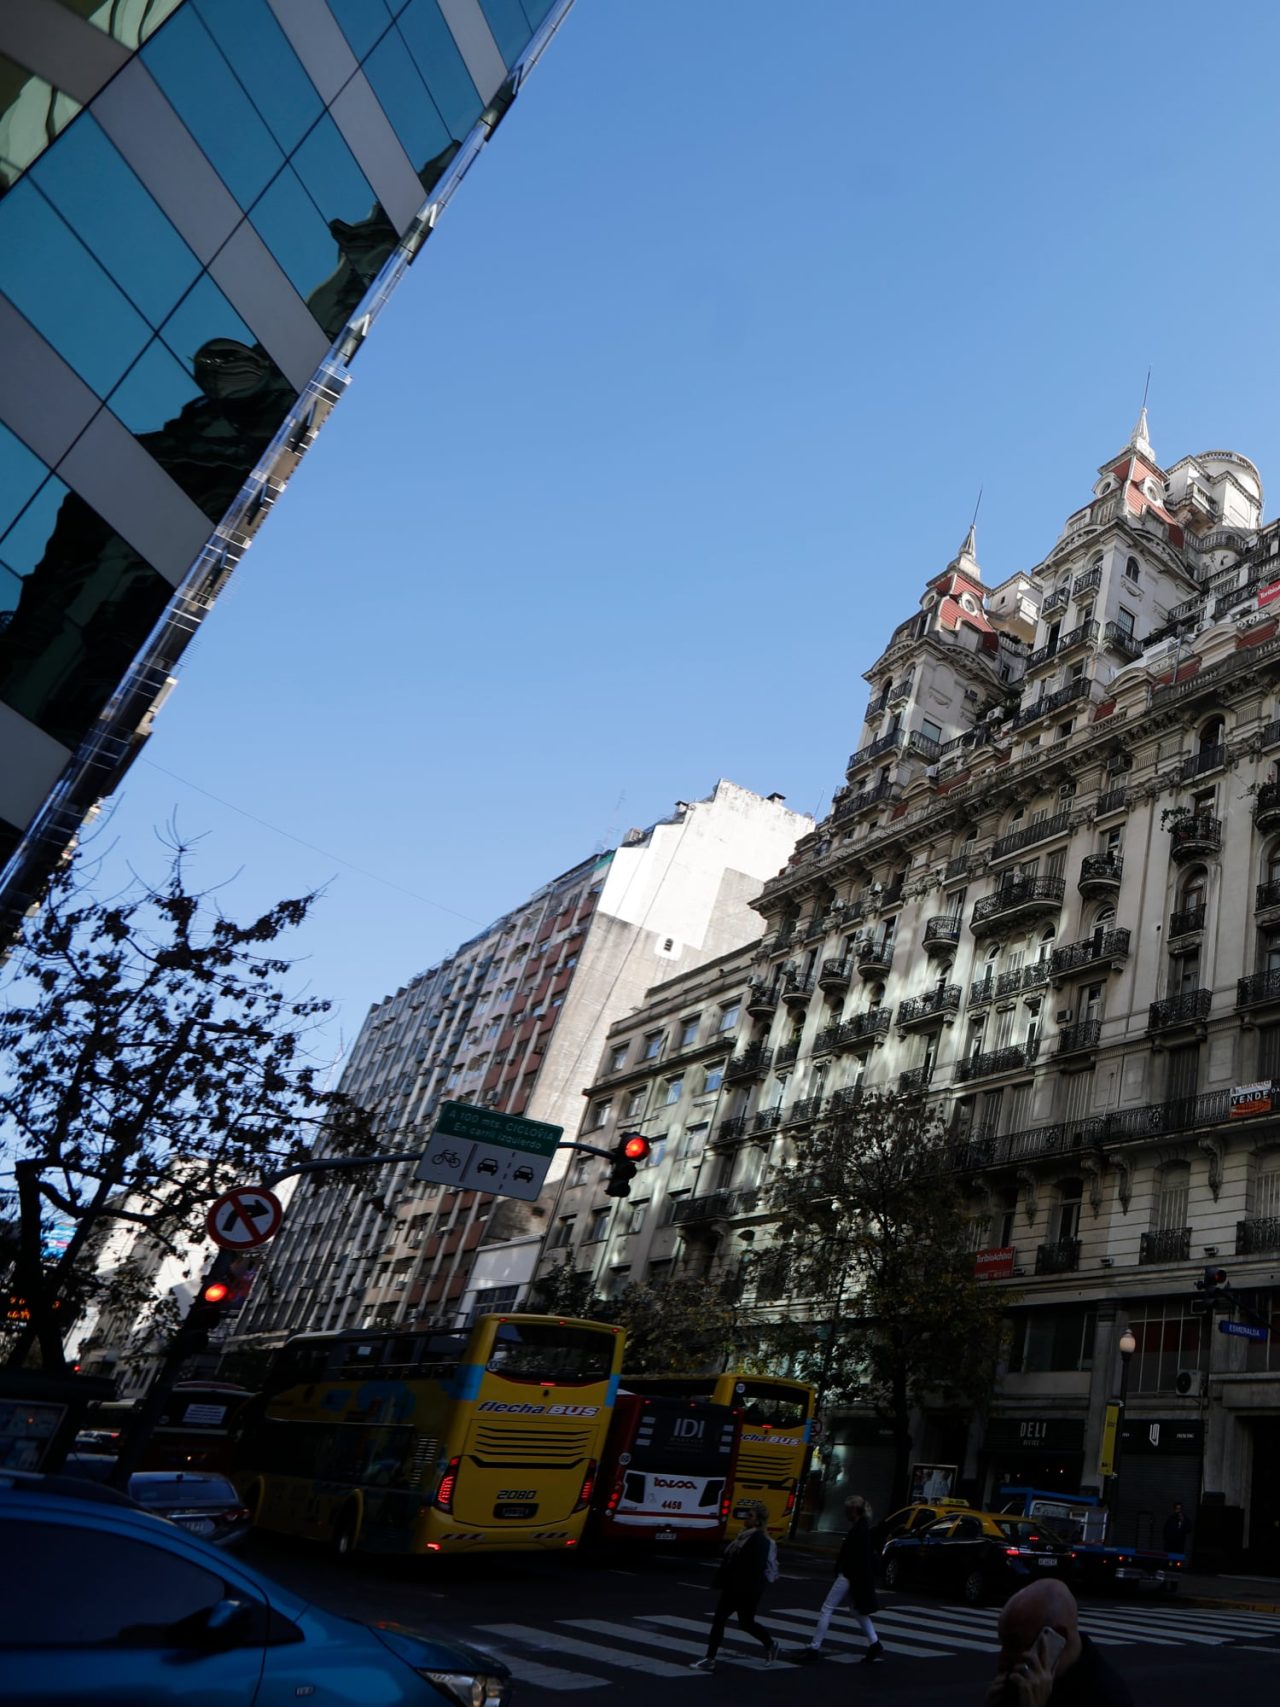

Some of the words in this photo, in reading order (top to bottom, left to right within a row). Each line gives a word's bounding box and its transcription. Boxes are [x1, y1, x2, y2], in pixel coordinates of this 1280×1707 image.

[1231, 1089, 1269, 1105] VENDE
[459, 1112, 480, 1123] 100
[453, 1122, 467, 1133] En
[469, 1126, 496, 1138] carril
[497, 1131, 543, 1150] izquierdo
[1228, 1323, 1261, 1337] ESMERALDA
[477, 1401, 545, 1415] flecha
[547, 1404, 600, 1418] BUS
[672, 1417, 705, 1439] IDI
[1019, 1421, 1047, 1439] DELI
[768, 1435, 801, 1447] BUS
[496, 1489, 537, 1500] 2080
[661, 1500, 682, 1510] 4458
